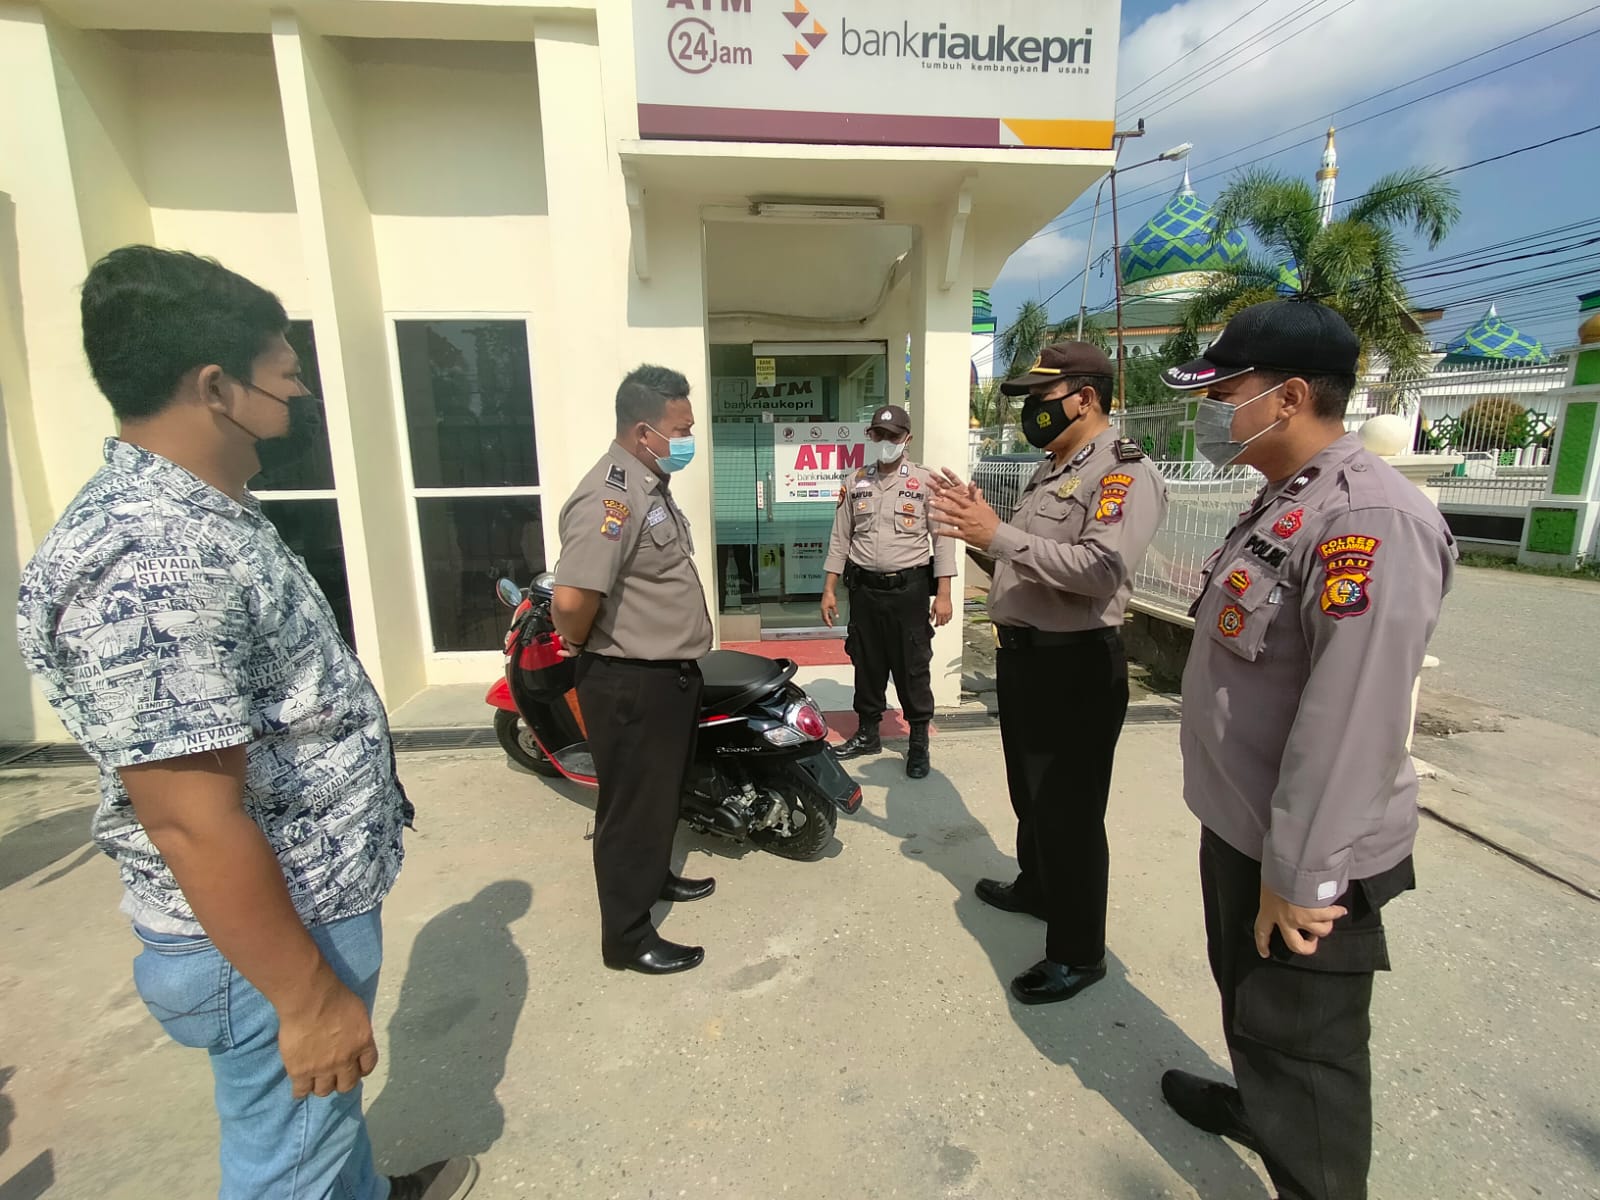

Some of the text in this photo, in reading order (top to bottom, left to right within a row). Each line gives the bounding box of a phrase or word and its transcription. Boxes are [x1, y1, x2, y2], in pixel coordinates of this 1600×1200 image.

[841, 17, 1093, 72] bankriaukepri
[921, 61, 1090, 74] tumbuh kembangkan usaha
[751, 381, 812, 400] ATM
[724, 400, 814, 411] bankriaukepri
[794, 443, 865, 471] ATM
[898, 490, 925, 500] POLRI
[1321, 536, 1376, 552] POLRES
[136, 558, 201, 572] NEVADA
[1328, 558, 1369, 569] RIAU
[139, 570, 188, 585] STATE
[248, 654, 289, 678] NEVADA
[186, 723, 243, 746] NEVADA
[312, 773, 349, 801] NEVADA
